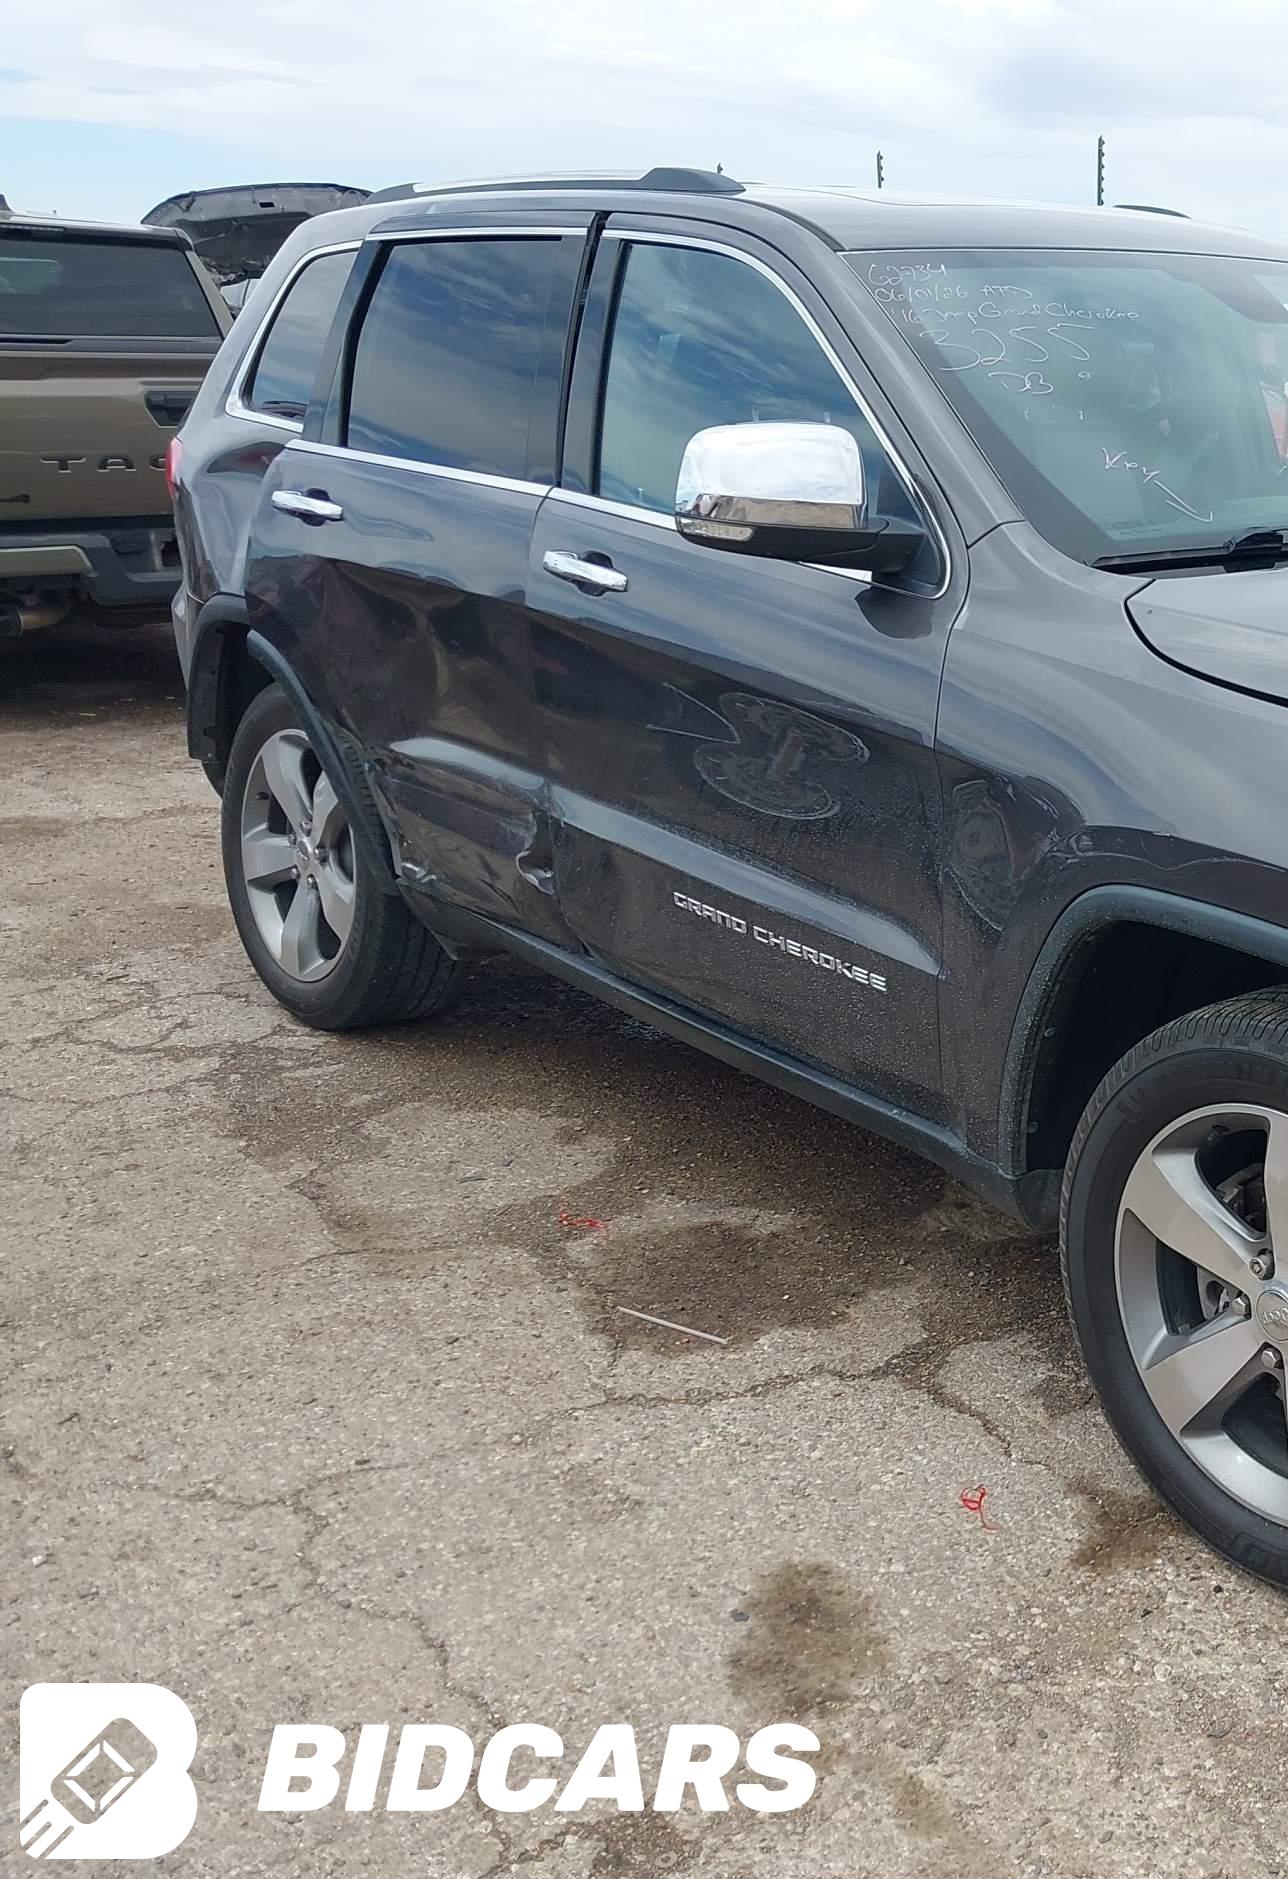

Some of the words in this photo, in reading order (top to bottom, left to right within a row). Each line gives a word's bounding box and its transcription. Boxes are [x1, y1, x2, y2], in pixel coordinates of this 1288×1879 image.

[868, 263, 947, 286] 62734
[918, 322, 1097, 372] 3255
[673, 891, 748, 935] GRAND
[752, 925, 887, 993] CHEROKEE
